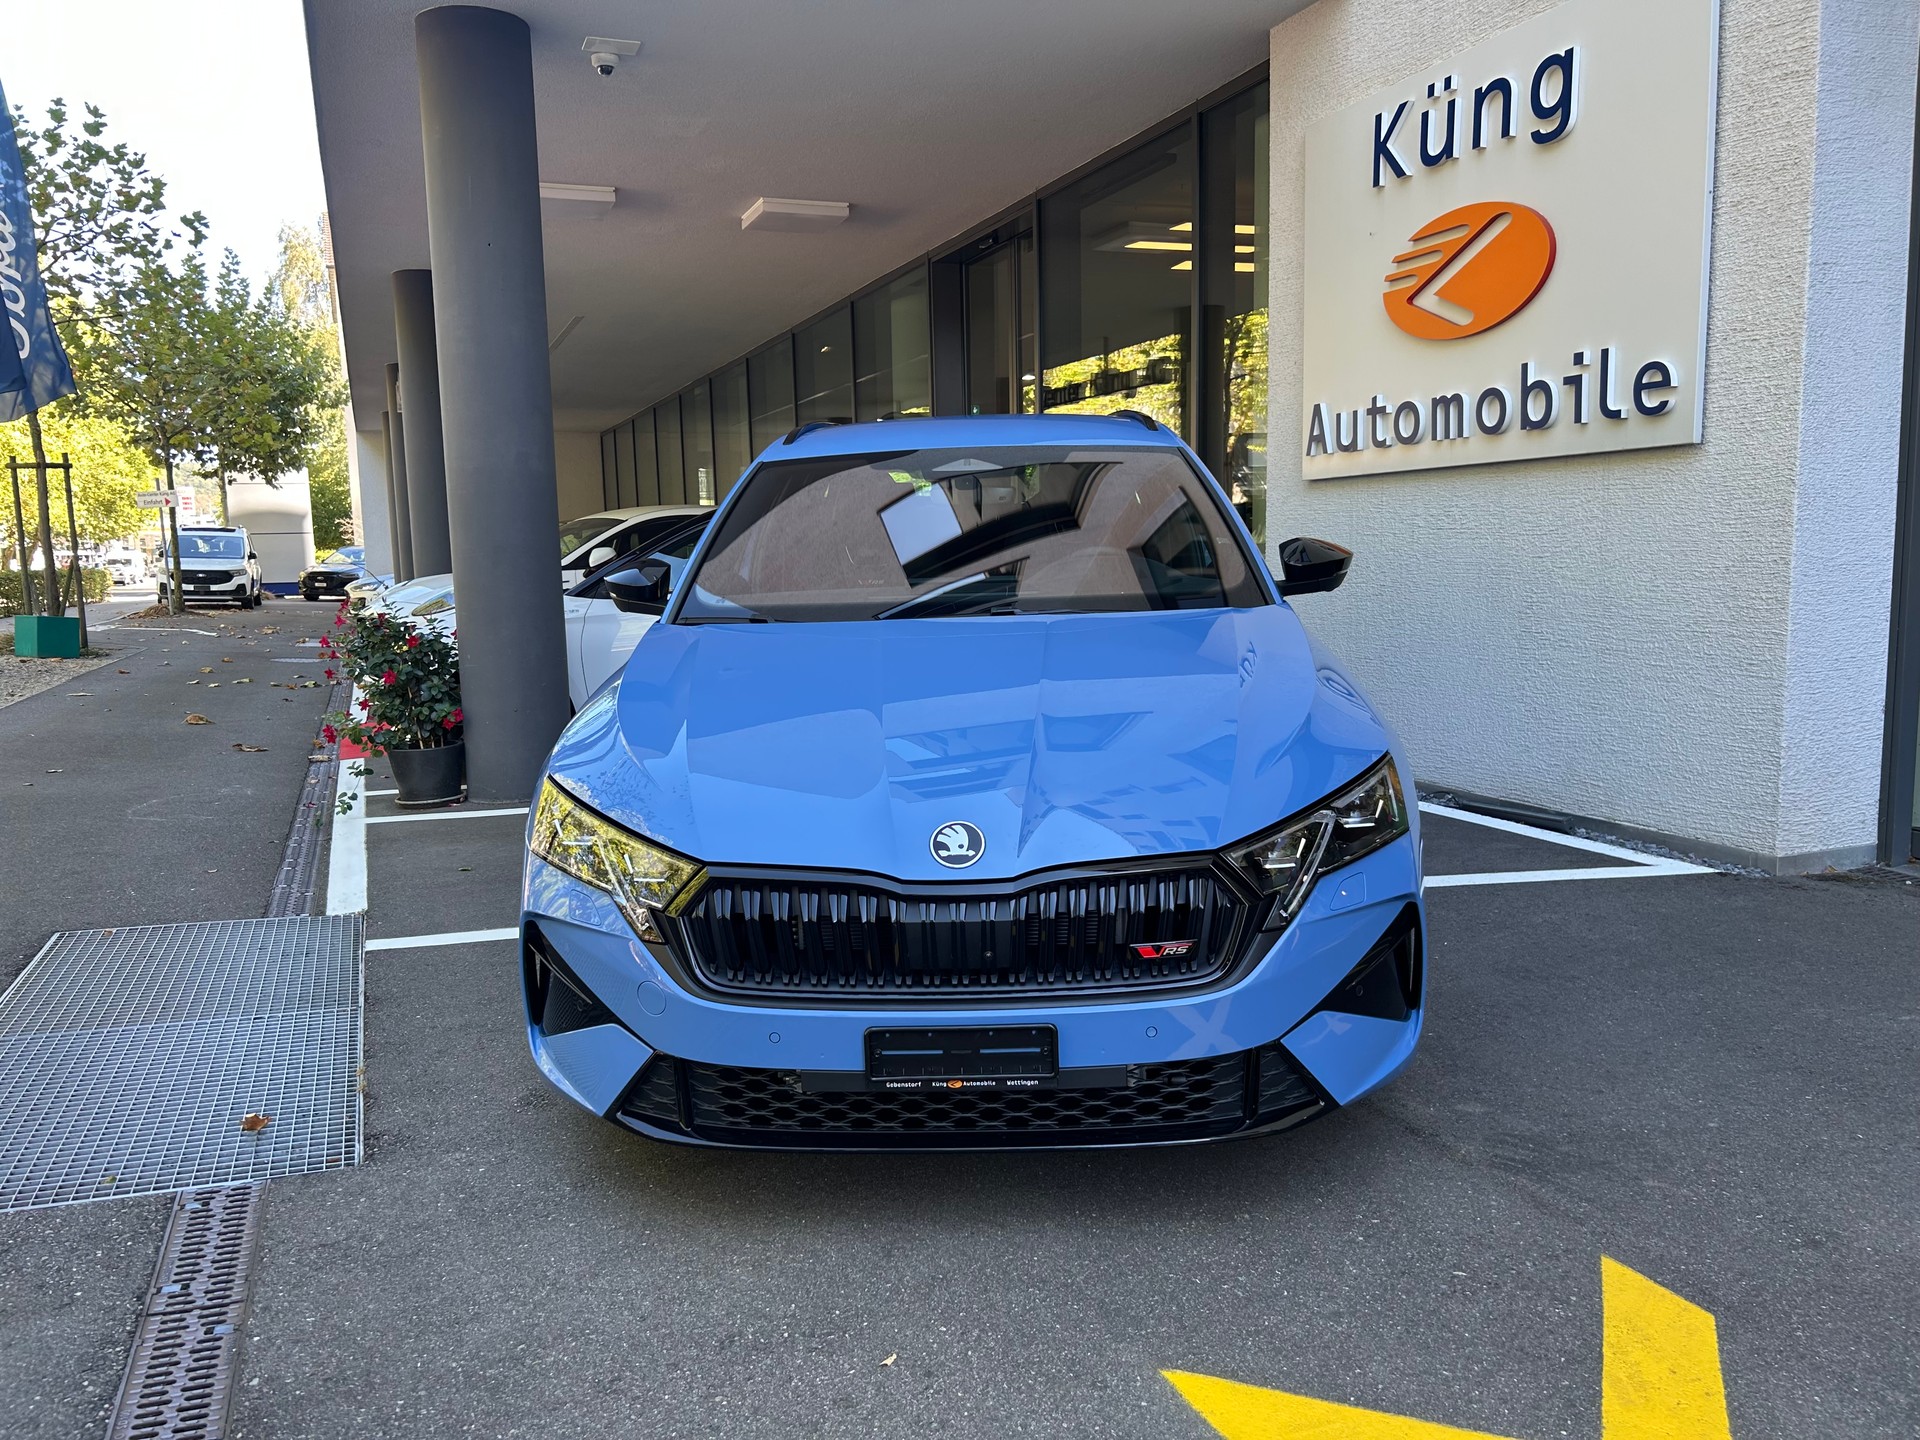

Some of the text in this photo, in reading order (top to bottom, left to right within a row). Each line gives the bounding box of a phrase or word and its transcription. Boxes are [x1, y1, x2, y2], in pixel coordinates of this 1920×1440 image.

[1372, 45, 1581, 189] Küng
[1305, 347, 1678, 457] Automobile
[1006, 1079, 1039, 1087] Wettingen
